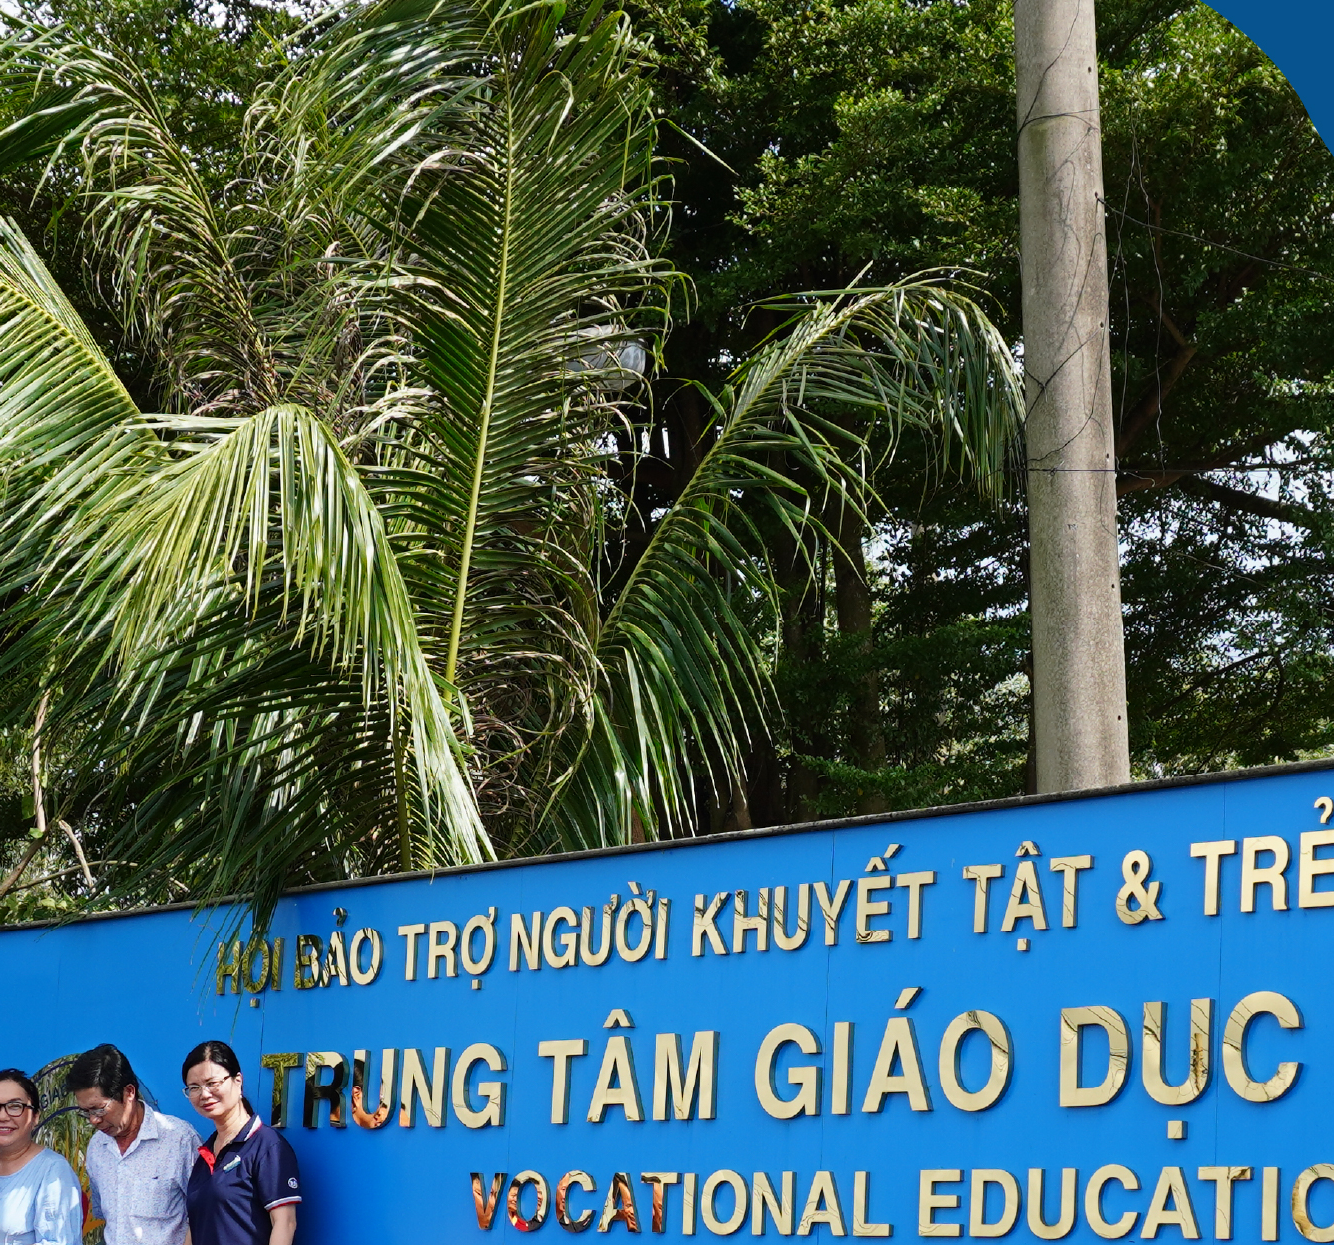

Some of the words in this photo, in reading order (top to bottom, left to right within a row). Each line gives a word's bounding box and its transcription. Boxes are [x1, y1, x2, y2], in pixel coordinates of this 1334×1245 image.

[294, 907, 383, 990] BẢO
[398, 906, 497, 990] TRỢ
[509, 881, 670, 971] NGƯỜI
[692, 844, 936, 957] KHUYẾT
[962, 841, 1094, 952] TẬT
[1116, 849, 1165, 925] &
[262, 1042, 508, 1129] TRUNG
[539, 1009, 720, 1124] TÂM
[756, 986, 1014, 1121] GIÁO
[1059, 991, 1304, 1140] DỤC
[470, 1169, 893, 1237] VOCATIONAL
